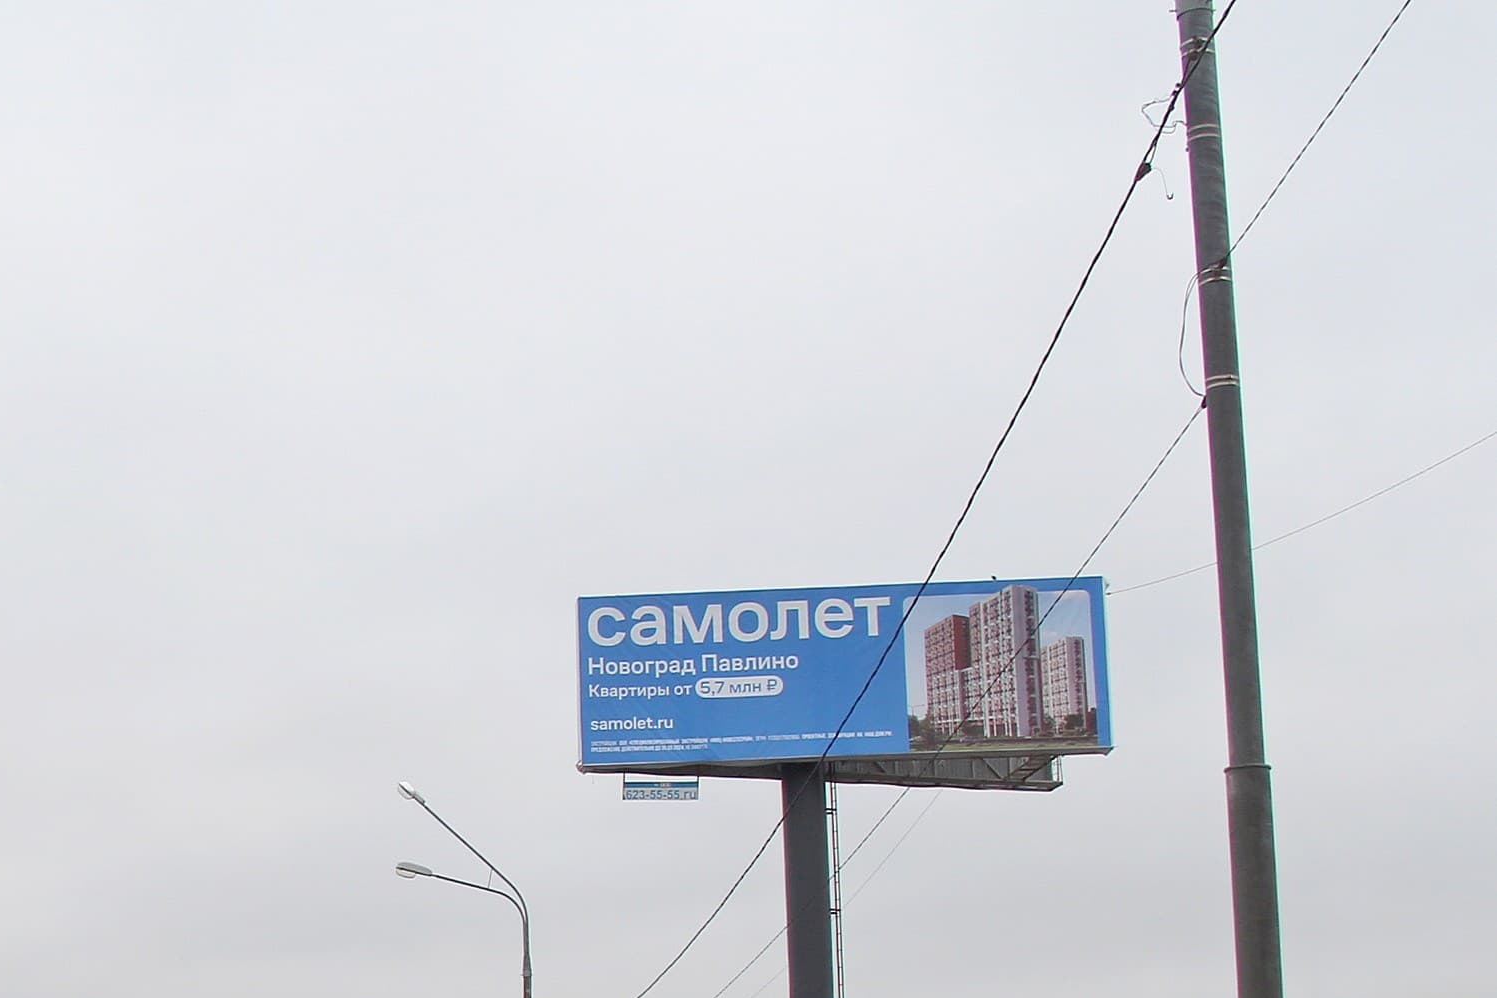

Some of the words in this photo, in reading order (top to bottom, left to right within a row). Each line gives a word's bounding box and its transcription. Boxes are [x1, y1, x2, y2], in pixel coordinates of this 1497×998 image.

[587, 596, 891, 647] самолет
[587, 656, 696, 678] Новоград
[701, 653, 799, 673] Павлино
[588, 683, 670, 700] Квартиры
[673, 685, 693, 696] от
[700, 681, 725, 697] 5,7
[729, 681, 762, 694] млн
[590, 716, 674, 731] samolet.ru
